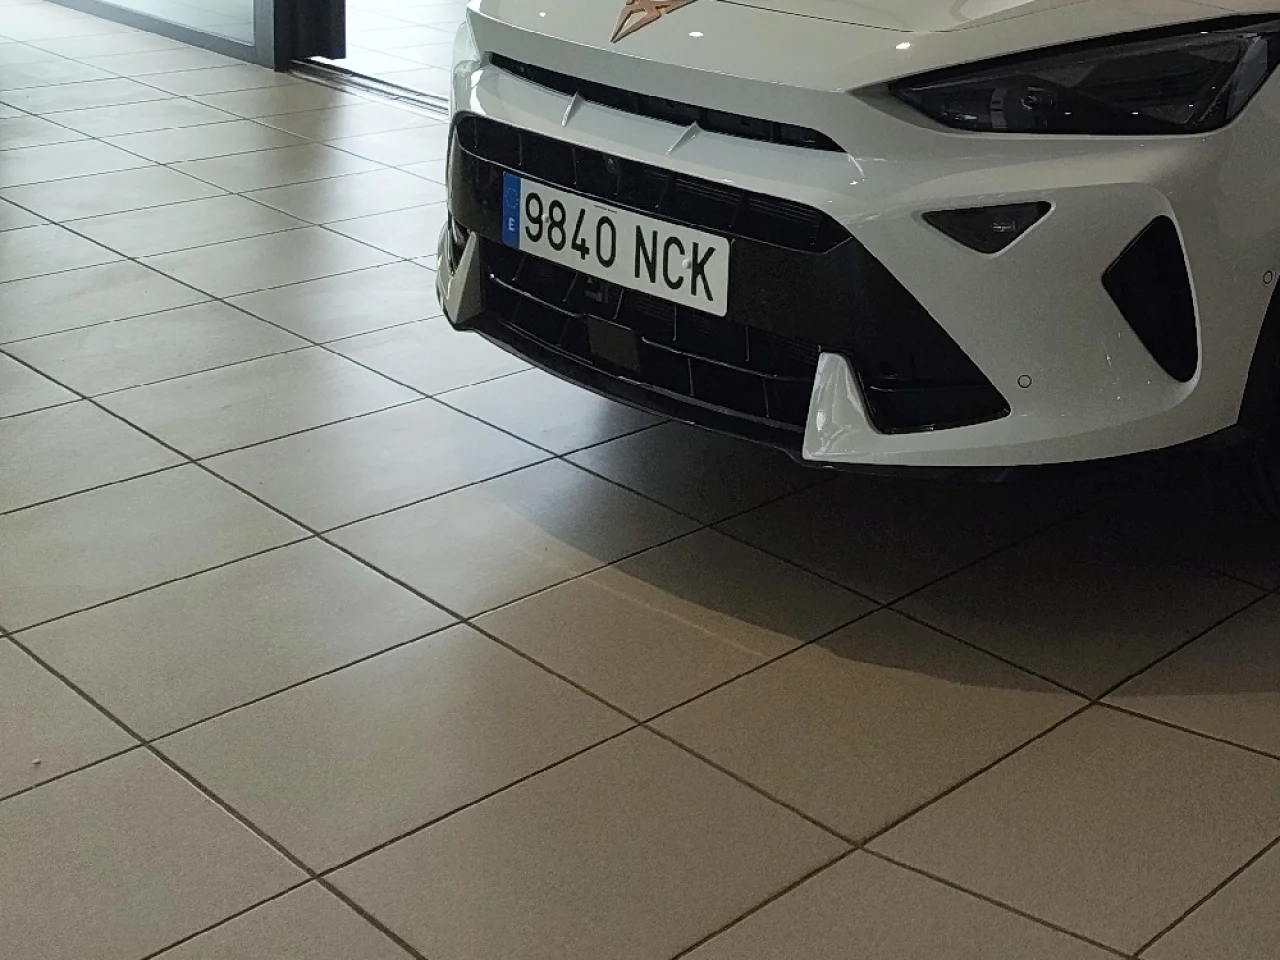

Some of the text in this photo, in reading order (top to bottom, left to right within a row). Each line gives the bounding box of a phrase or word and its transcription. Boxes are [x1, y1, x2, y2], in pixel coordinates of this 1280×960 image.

[507, 216, 516, 232] E
[524, 191, 716, 302] 9840 NCK
